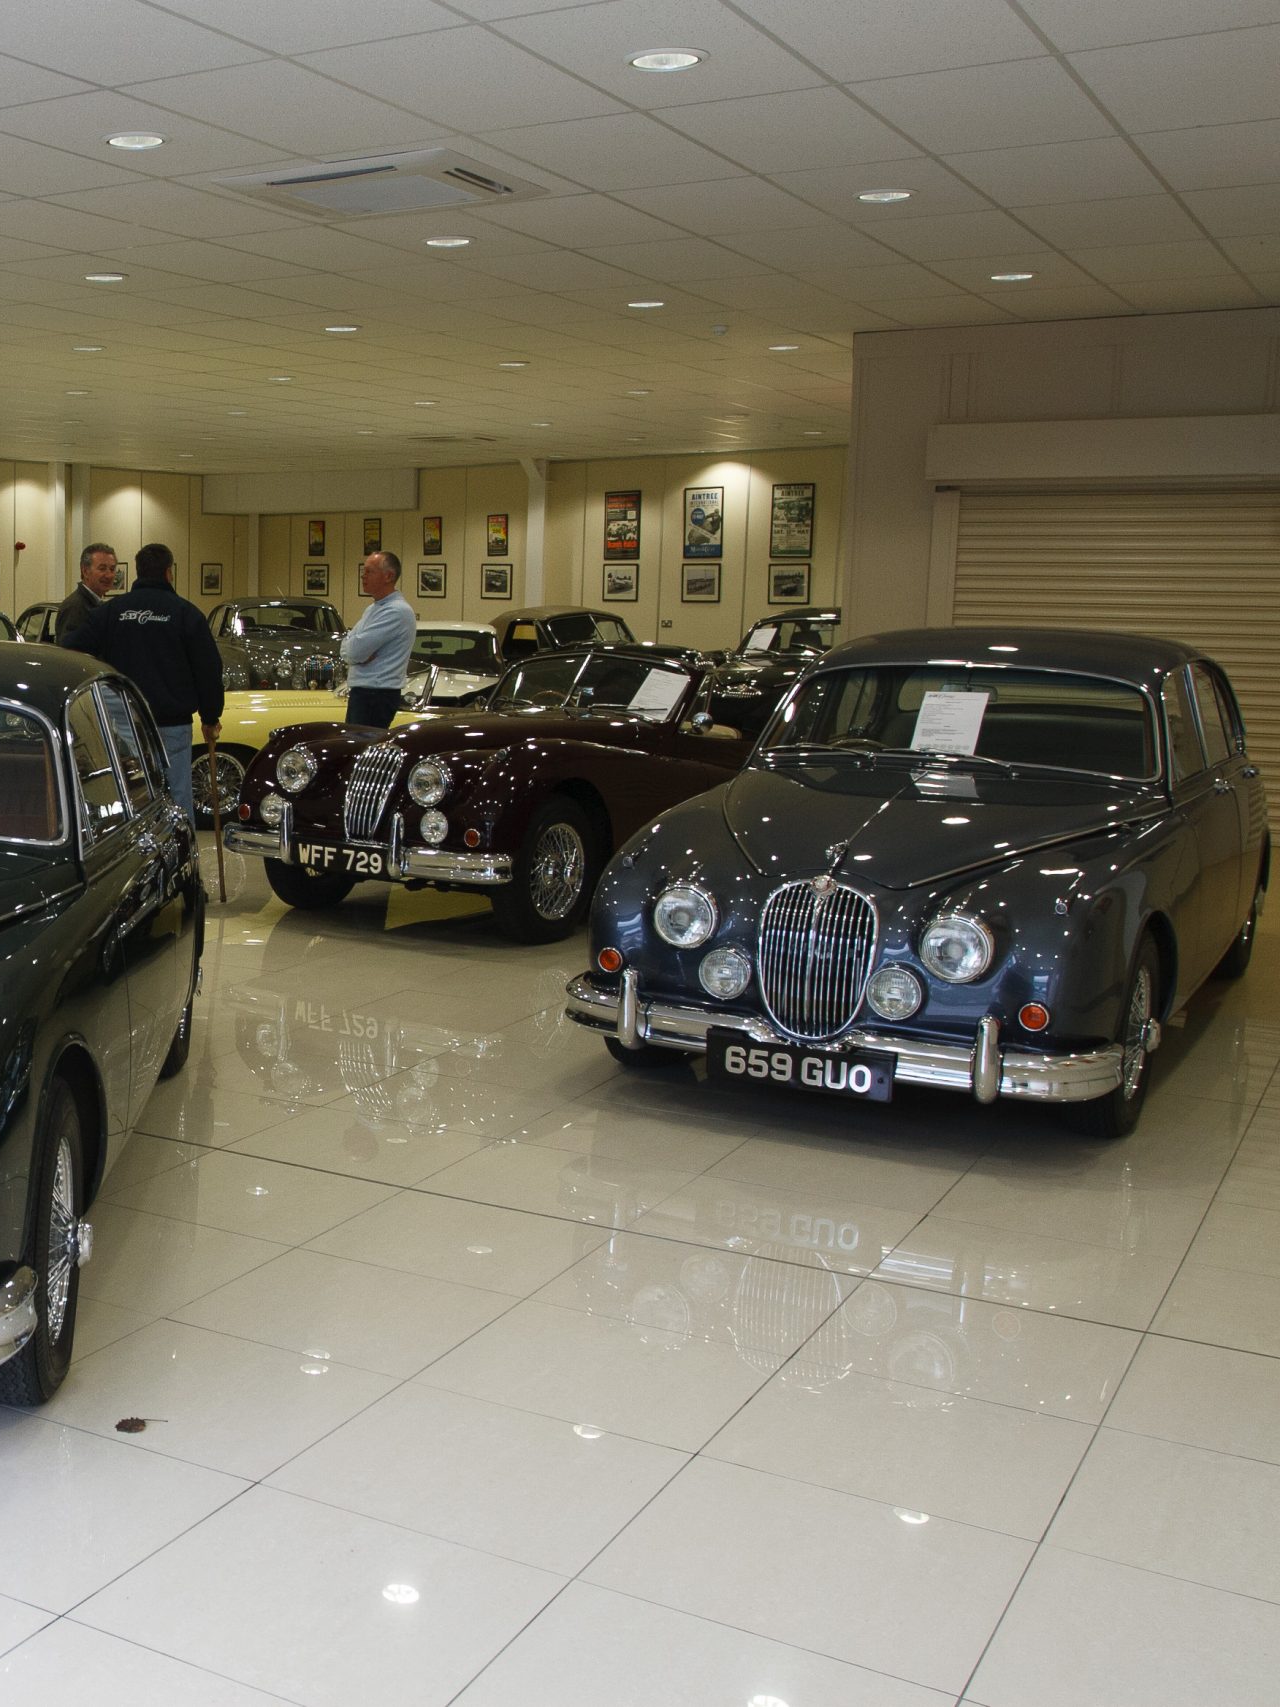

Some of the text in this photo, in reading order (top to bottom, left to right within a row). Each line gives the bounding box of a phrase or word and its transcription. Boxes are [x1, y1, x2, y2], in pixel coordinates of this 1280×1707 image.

[691, 492, 719, 500] AINTREE
[137, 609, 171, 624] Classics
[298, 843, 383, 875] WFF 729
[724, 1045, 872, 1094] 659 GUO
